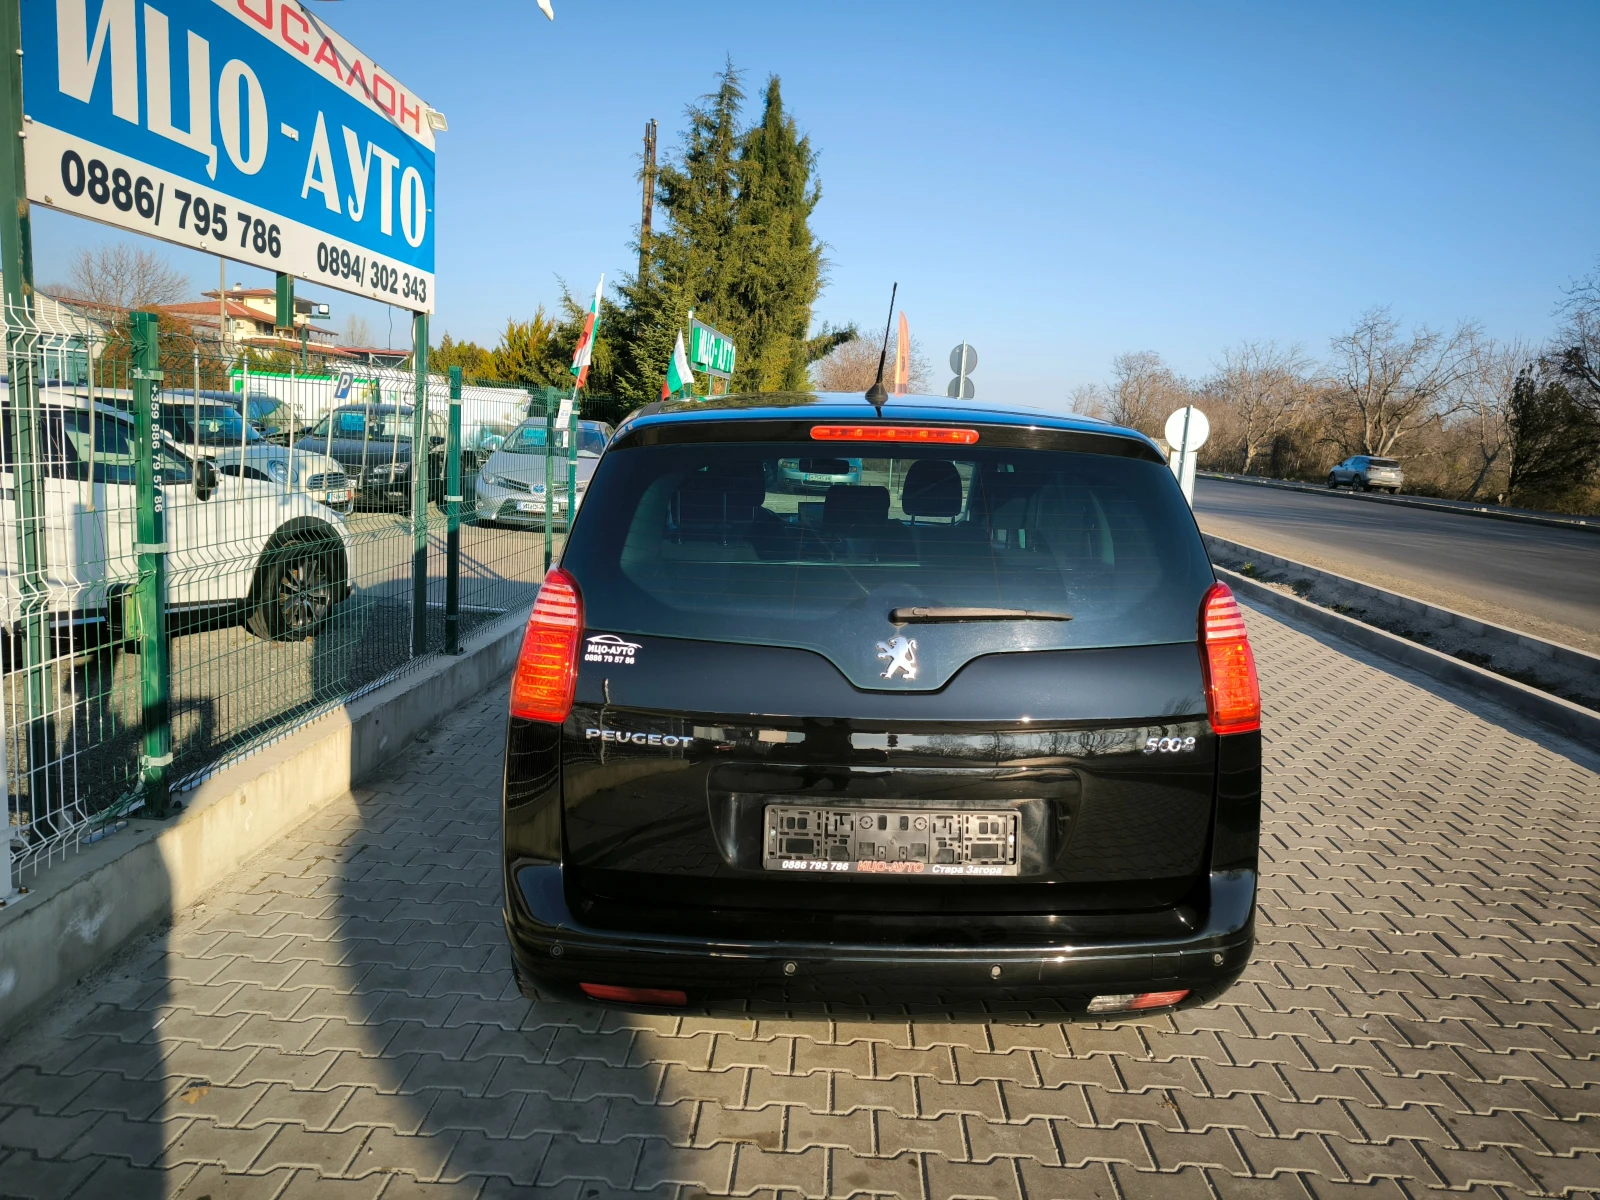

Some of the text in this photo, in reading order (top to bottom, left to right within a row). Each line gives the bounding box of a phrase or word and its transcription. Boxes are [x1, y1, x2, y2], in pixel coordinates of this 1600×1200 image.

[61, 150, 282, 259] 0886/ 795 786
[317, 241, 427, 303] 0894/ 302 343
[150, 384, 163, 513] +359 886 79 57 86
[587, 644, 635, 656] ИЦО-АУТО
[603, 655, 613, 663] 79
[624, 656, 635, 664] 86
[585, 728, 694, 748] PEUGEOT
[1143, 736, 1196, 754] 5008
[782, 860, 1004, 876] 0886 795 786 ИЦО-АУТО Стара Загора
